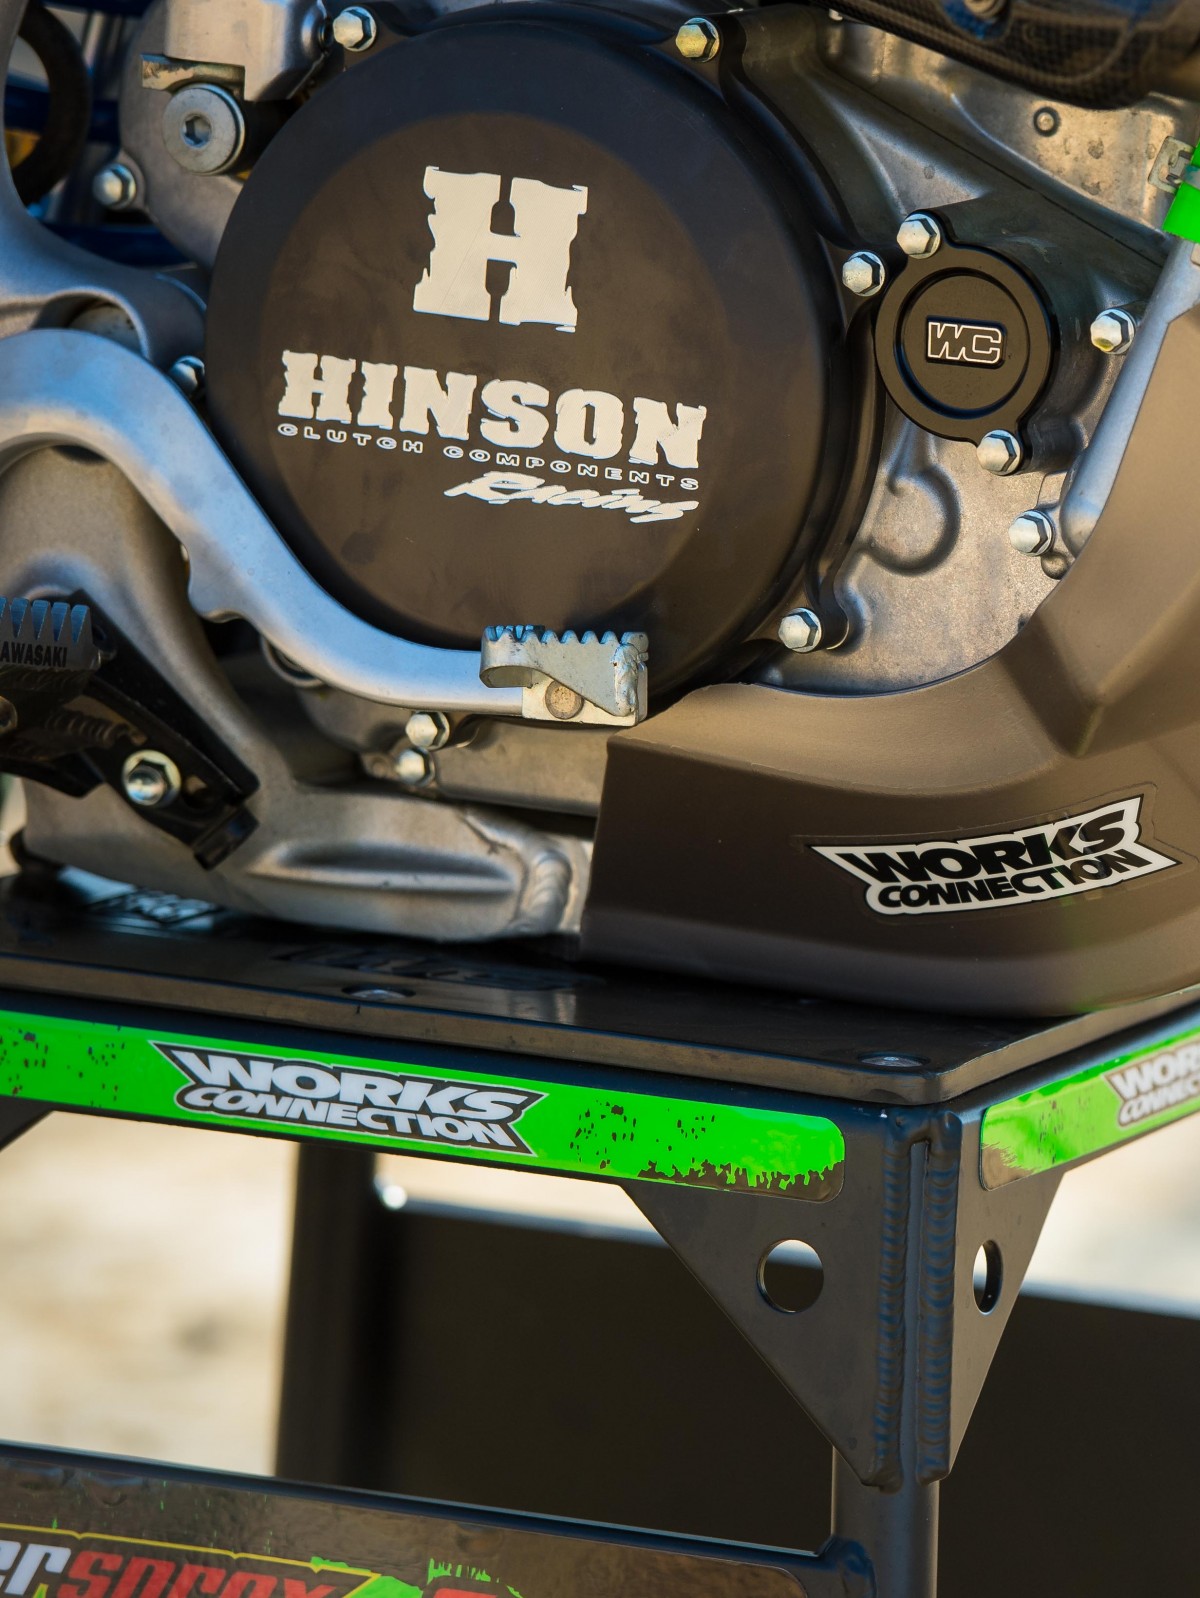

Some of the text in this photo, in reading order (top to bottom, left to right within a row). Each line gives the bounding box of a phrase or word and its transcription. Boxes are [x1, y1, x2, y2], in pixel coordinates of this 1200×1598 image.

[413, 166, 588, 332] H
[928, 321, 1002, 364] WC
[278, 350, 707, 469] HINSON
[277, 423, 699, 490] CLUTCH COMPONENTS
[444, 471, 699, 523] Racing
[835, 809, 1126, 883] WORKS
[877, 848, 1154, 908] CONNECTION
[169, 1049, 530, 1121] WORKS
[184, 1087, 518, 1149] CONNECTION
